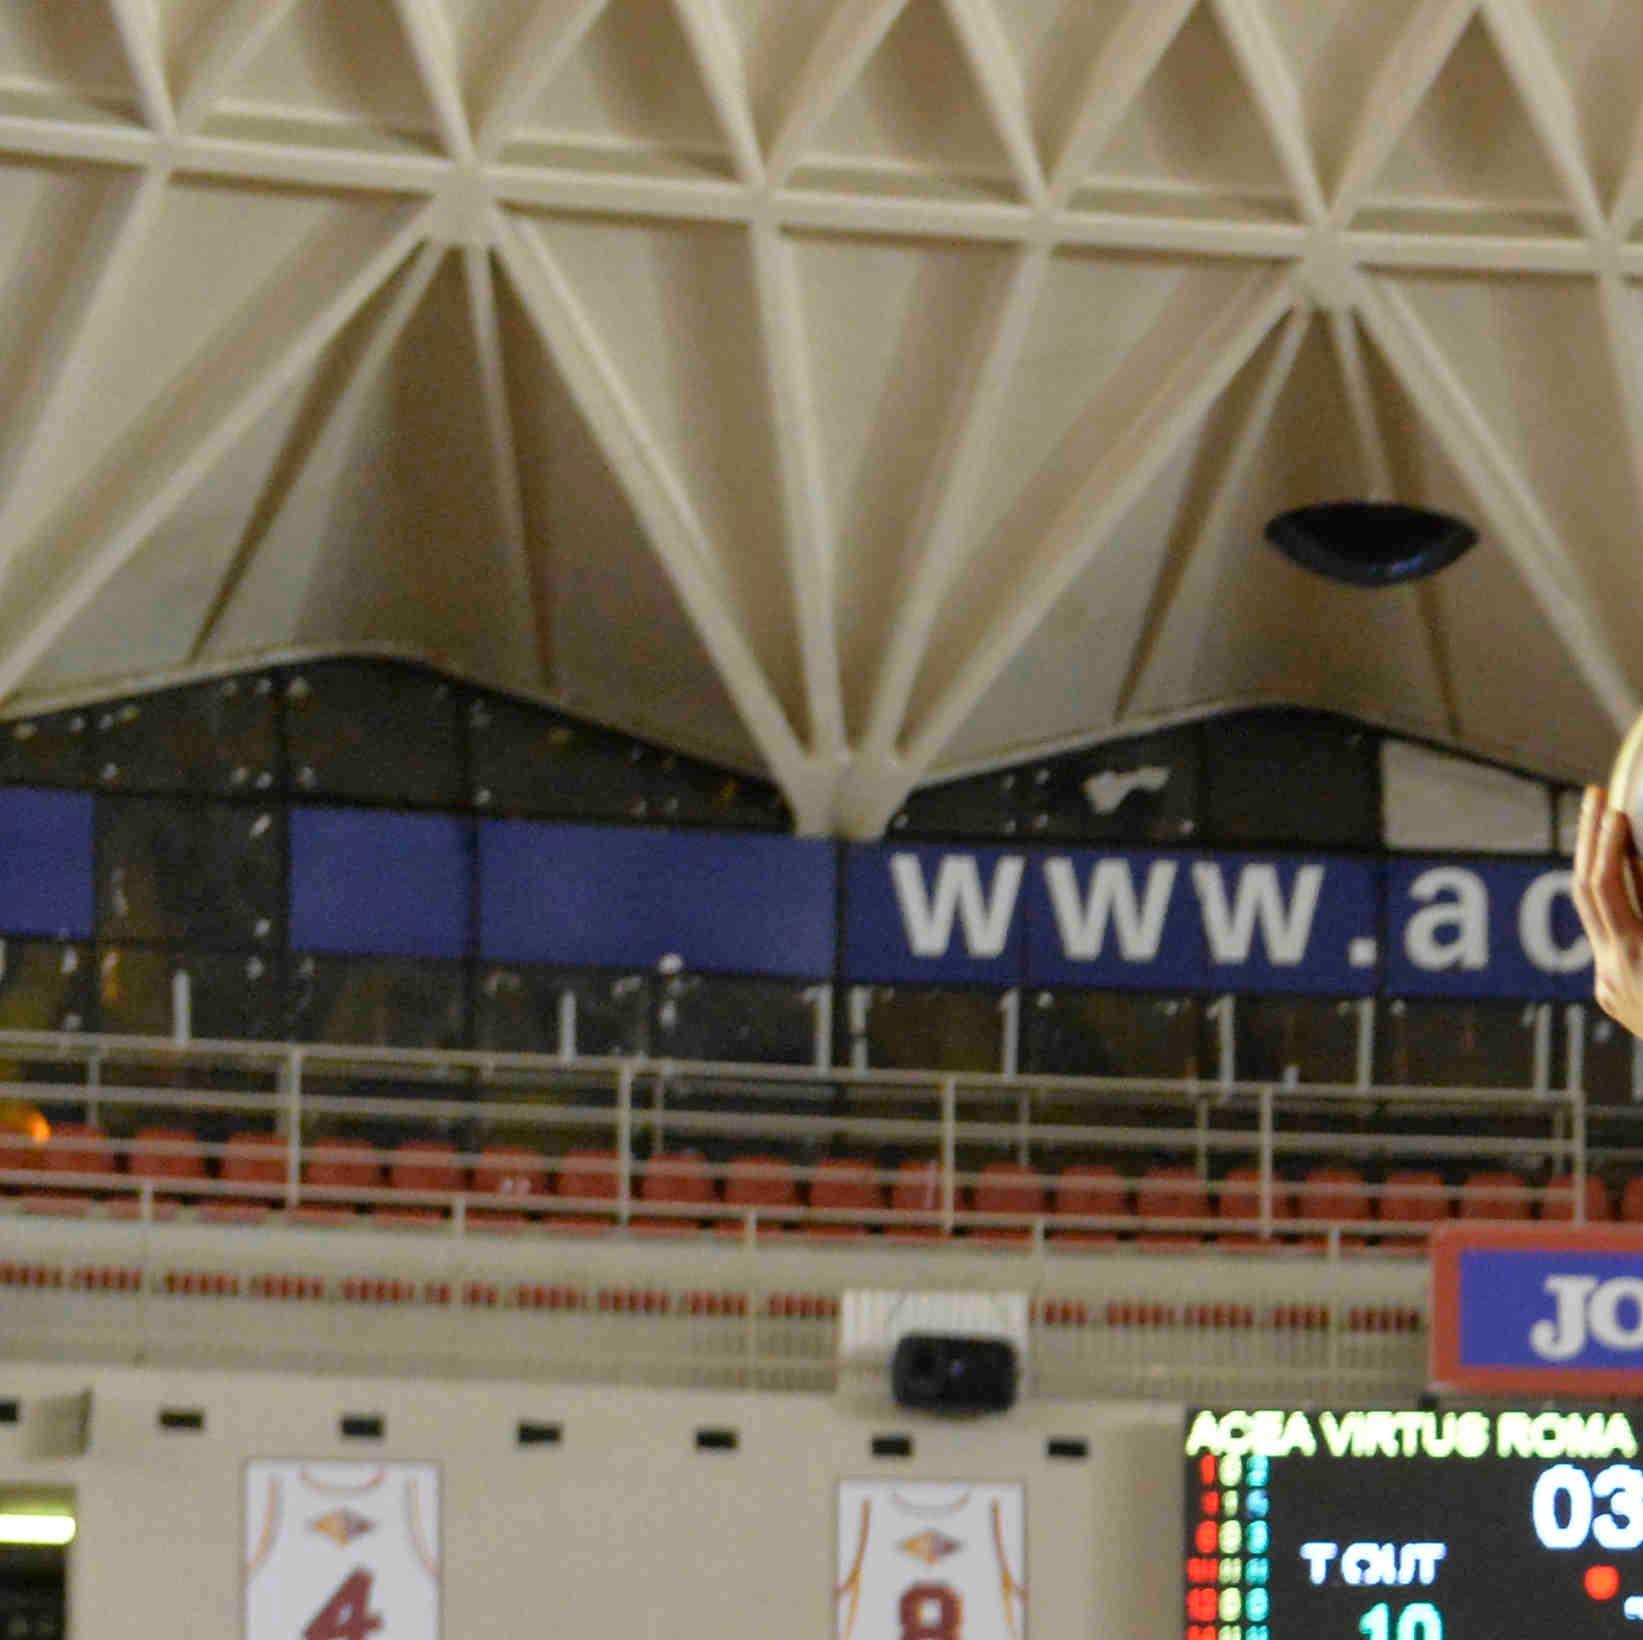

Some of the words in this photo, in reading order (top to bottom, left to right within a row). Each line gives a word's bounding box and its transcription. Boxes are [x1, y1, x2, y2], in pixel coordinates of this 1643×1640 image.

[1185, 1410, 1317, 1458] ACEA
[1319, 1411, 1490, 1459] VIRTUS
[1496, 1411, 1639, 1459] ROMA
